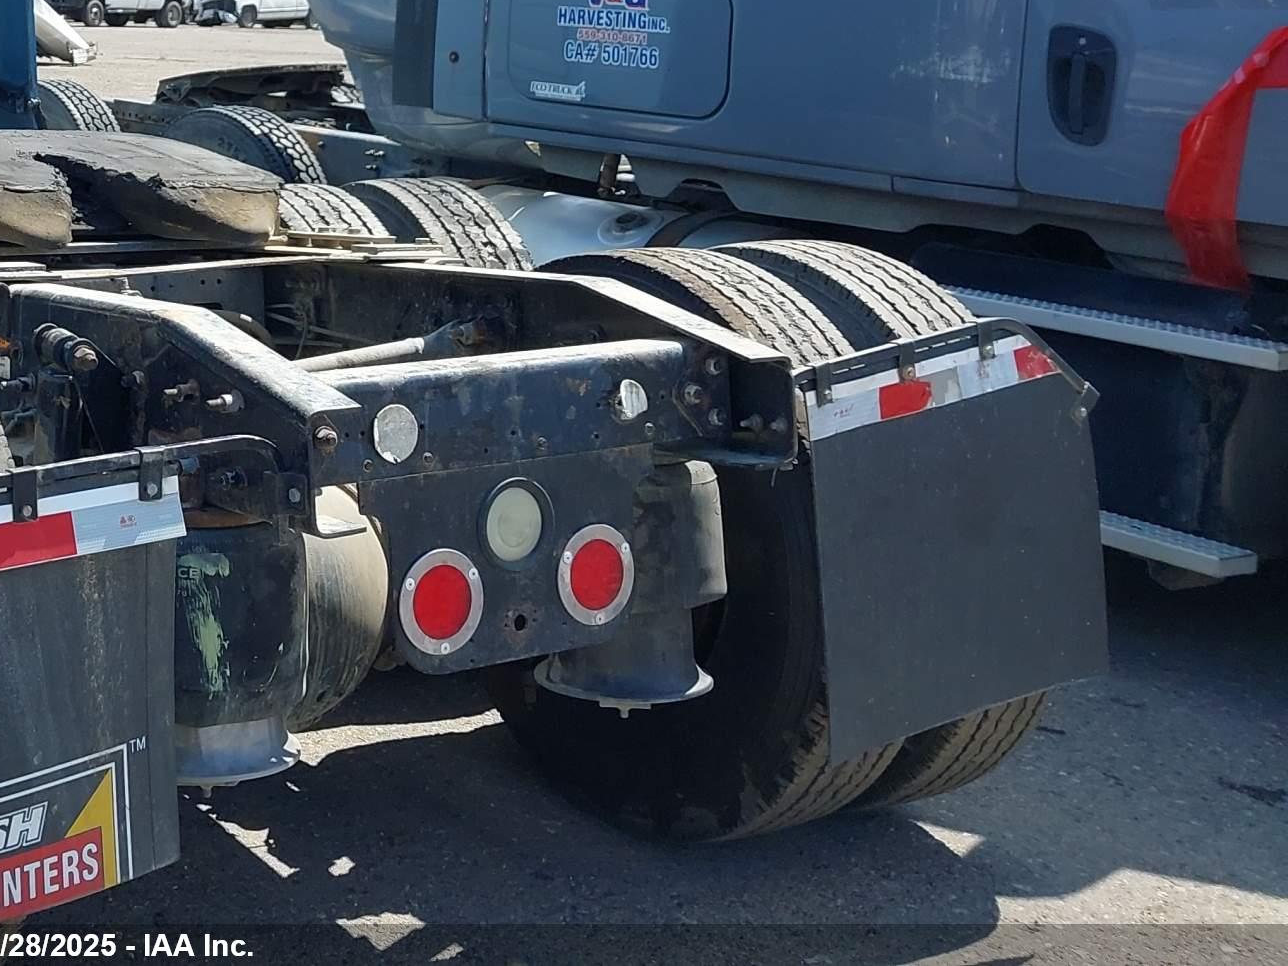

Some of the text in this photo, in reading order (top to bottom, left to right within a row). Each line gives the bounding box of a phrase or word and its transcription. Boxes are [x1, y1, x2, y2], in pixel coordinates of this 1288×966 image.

[564, 40, 660, 68] CA# 501766
[128, 735, 146, 753] TM
